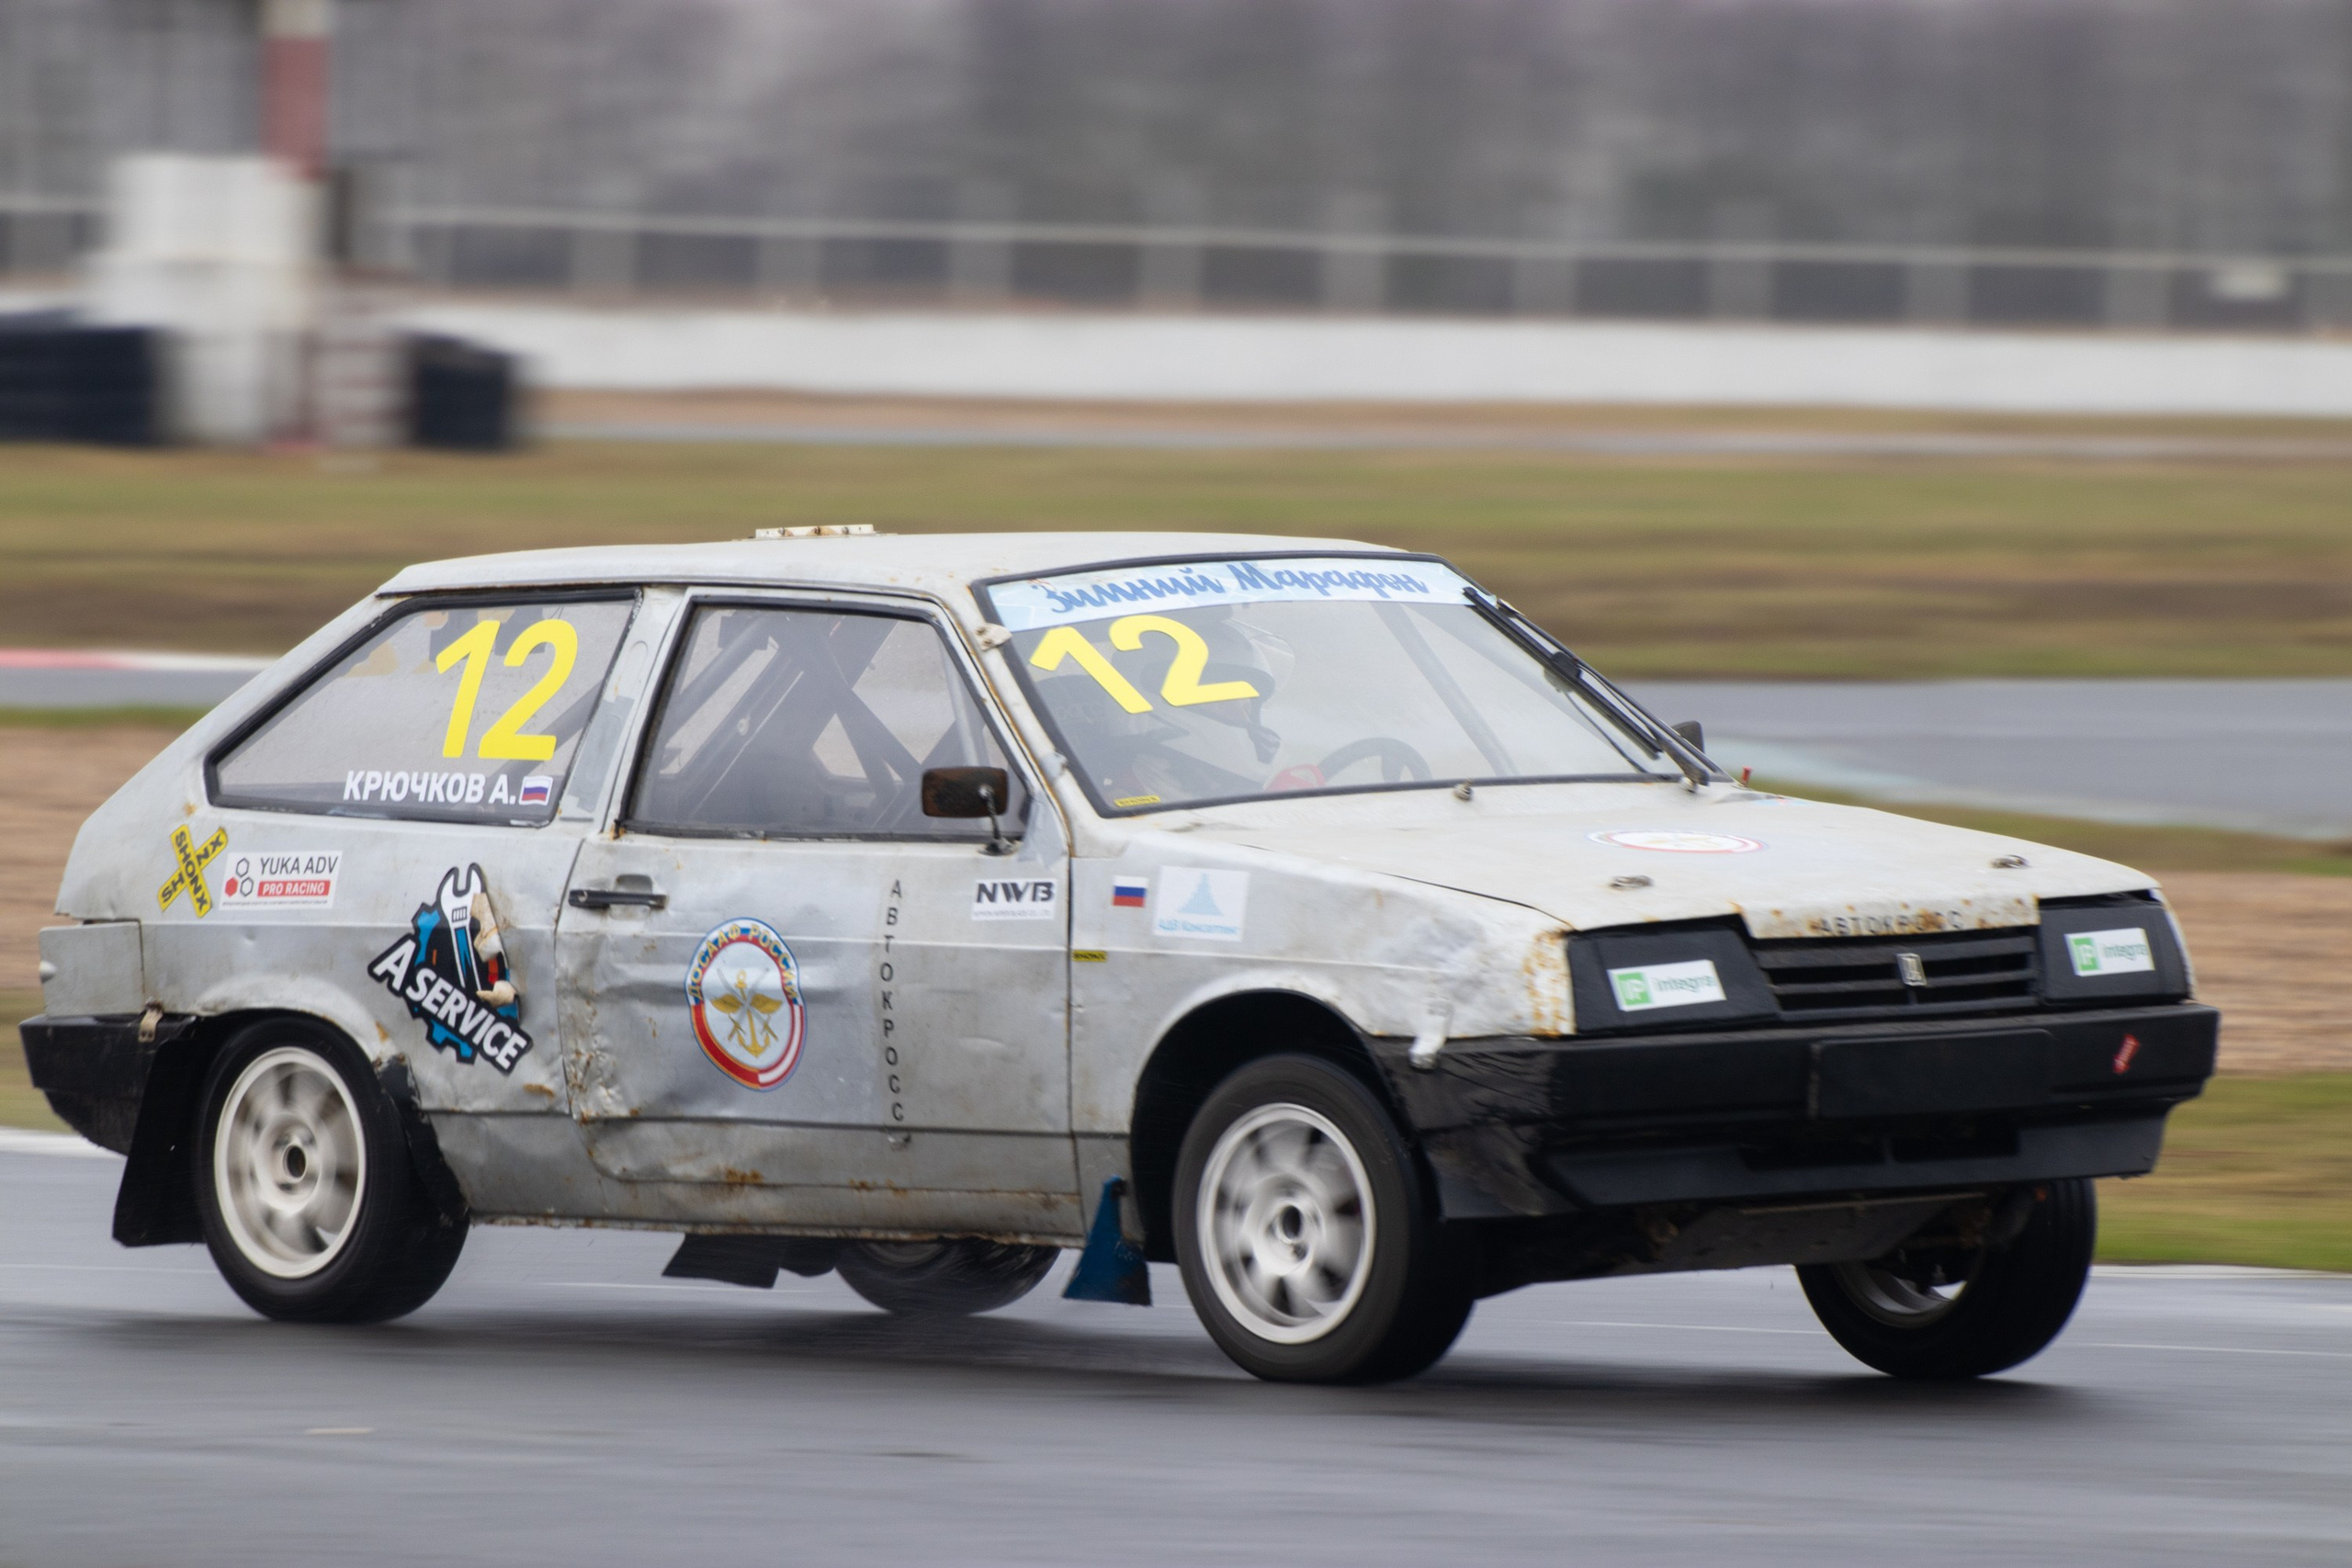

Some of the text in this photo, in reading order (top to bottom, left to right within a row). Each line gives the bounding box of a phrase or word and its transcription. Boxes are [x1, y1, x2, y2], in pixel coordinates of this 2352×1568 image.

[1031, 562, 1430, 614] Зимний Марафон
[435, 618, 578, 761] 12
[1029, 615, 1261, 714] 12
[343, 770, 516, 805] КРЮЧКОВ А.
[161, 833, 224, 903] SHNX
[260, 855, 339, 875] YUKA ADV
[262, 881, 325, 896] PRO RACING
[976, 882, 1054, 903] NWB
[688, 924, 799, 1001] ДОСААФ РОССИИ
[373, 939, 527, 1070] A SERVICE
[880, 879, 904, 1122] АВТОКРОСС
